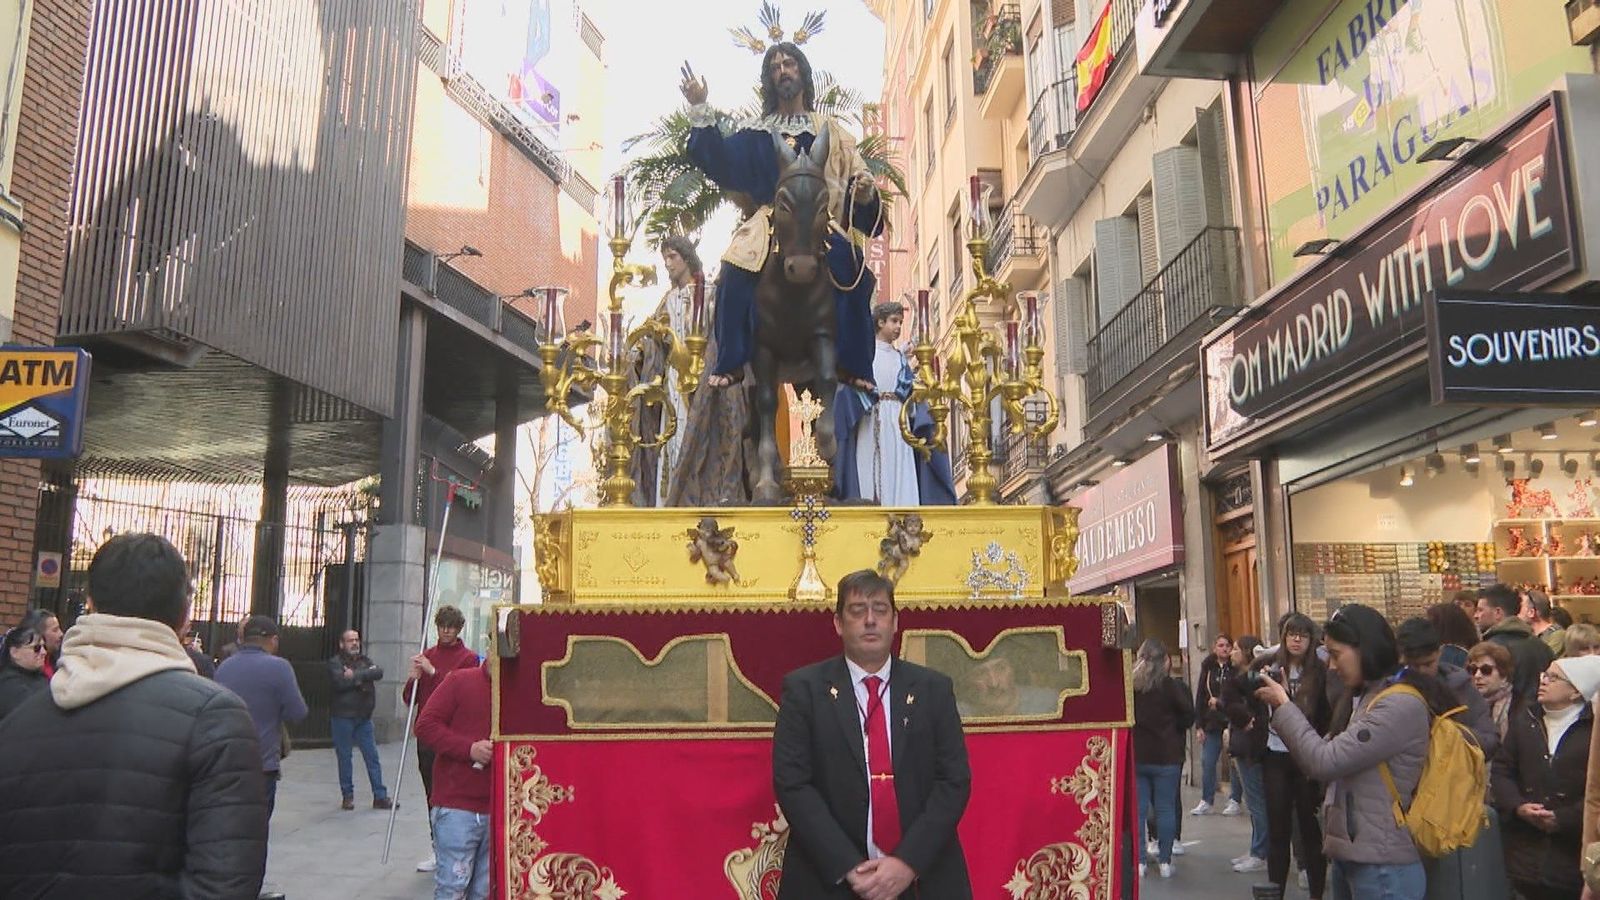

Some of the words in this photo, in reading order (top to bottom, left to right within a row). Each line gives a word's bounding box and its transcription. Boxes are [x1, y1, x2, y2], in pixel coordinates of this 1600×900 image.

[1267, 289, 1352, 387] MADRID
[1358, 230, 1433, 329] WITH
[1440, 154, 1553, 287] LOVE
[1447, 325, 1600, 368] SOUVENIRS
[0, 360, 74, 386] ATM
[8, 416, 50, 428] Euronet
